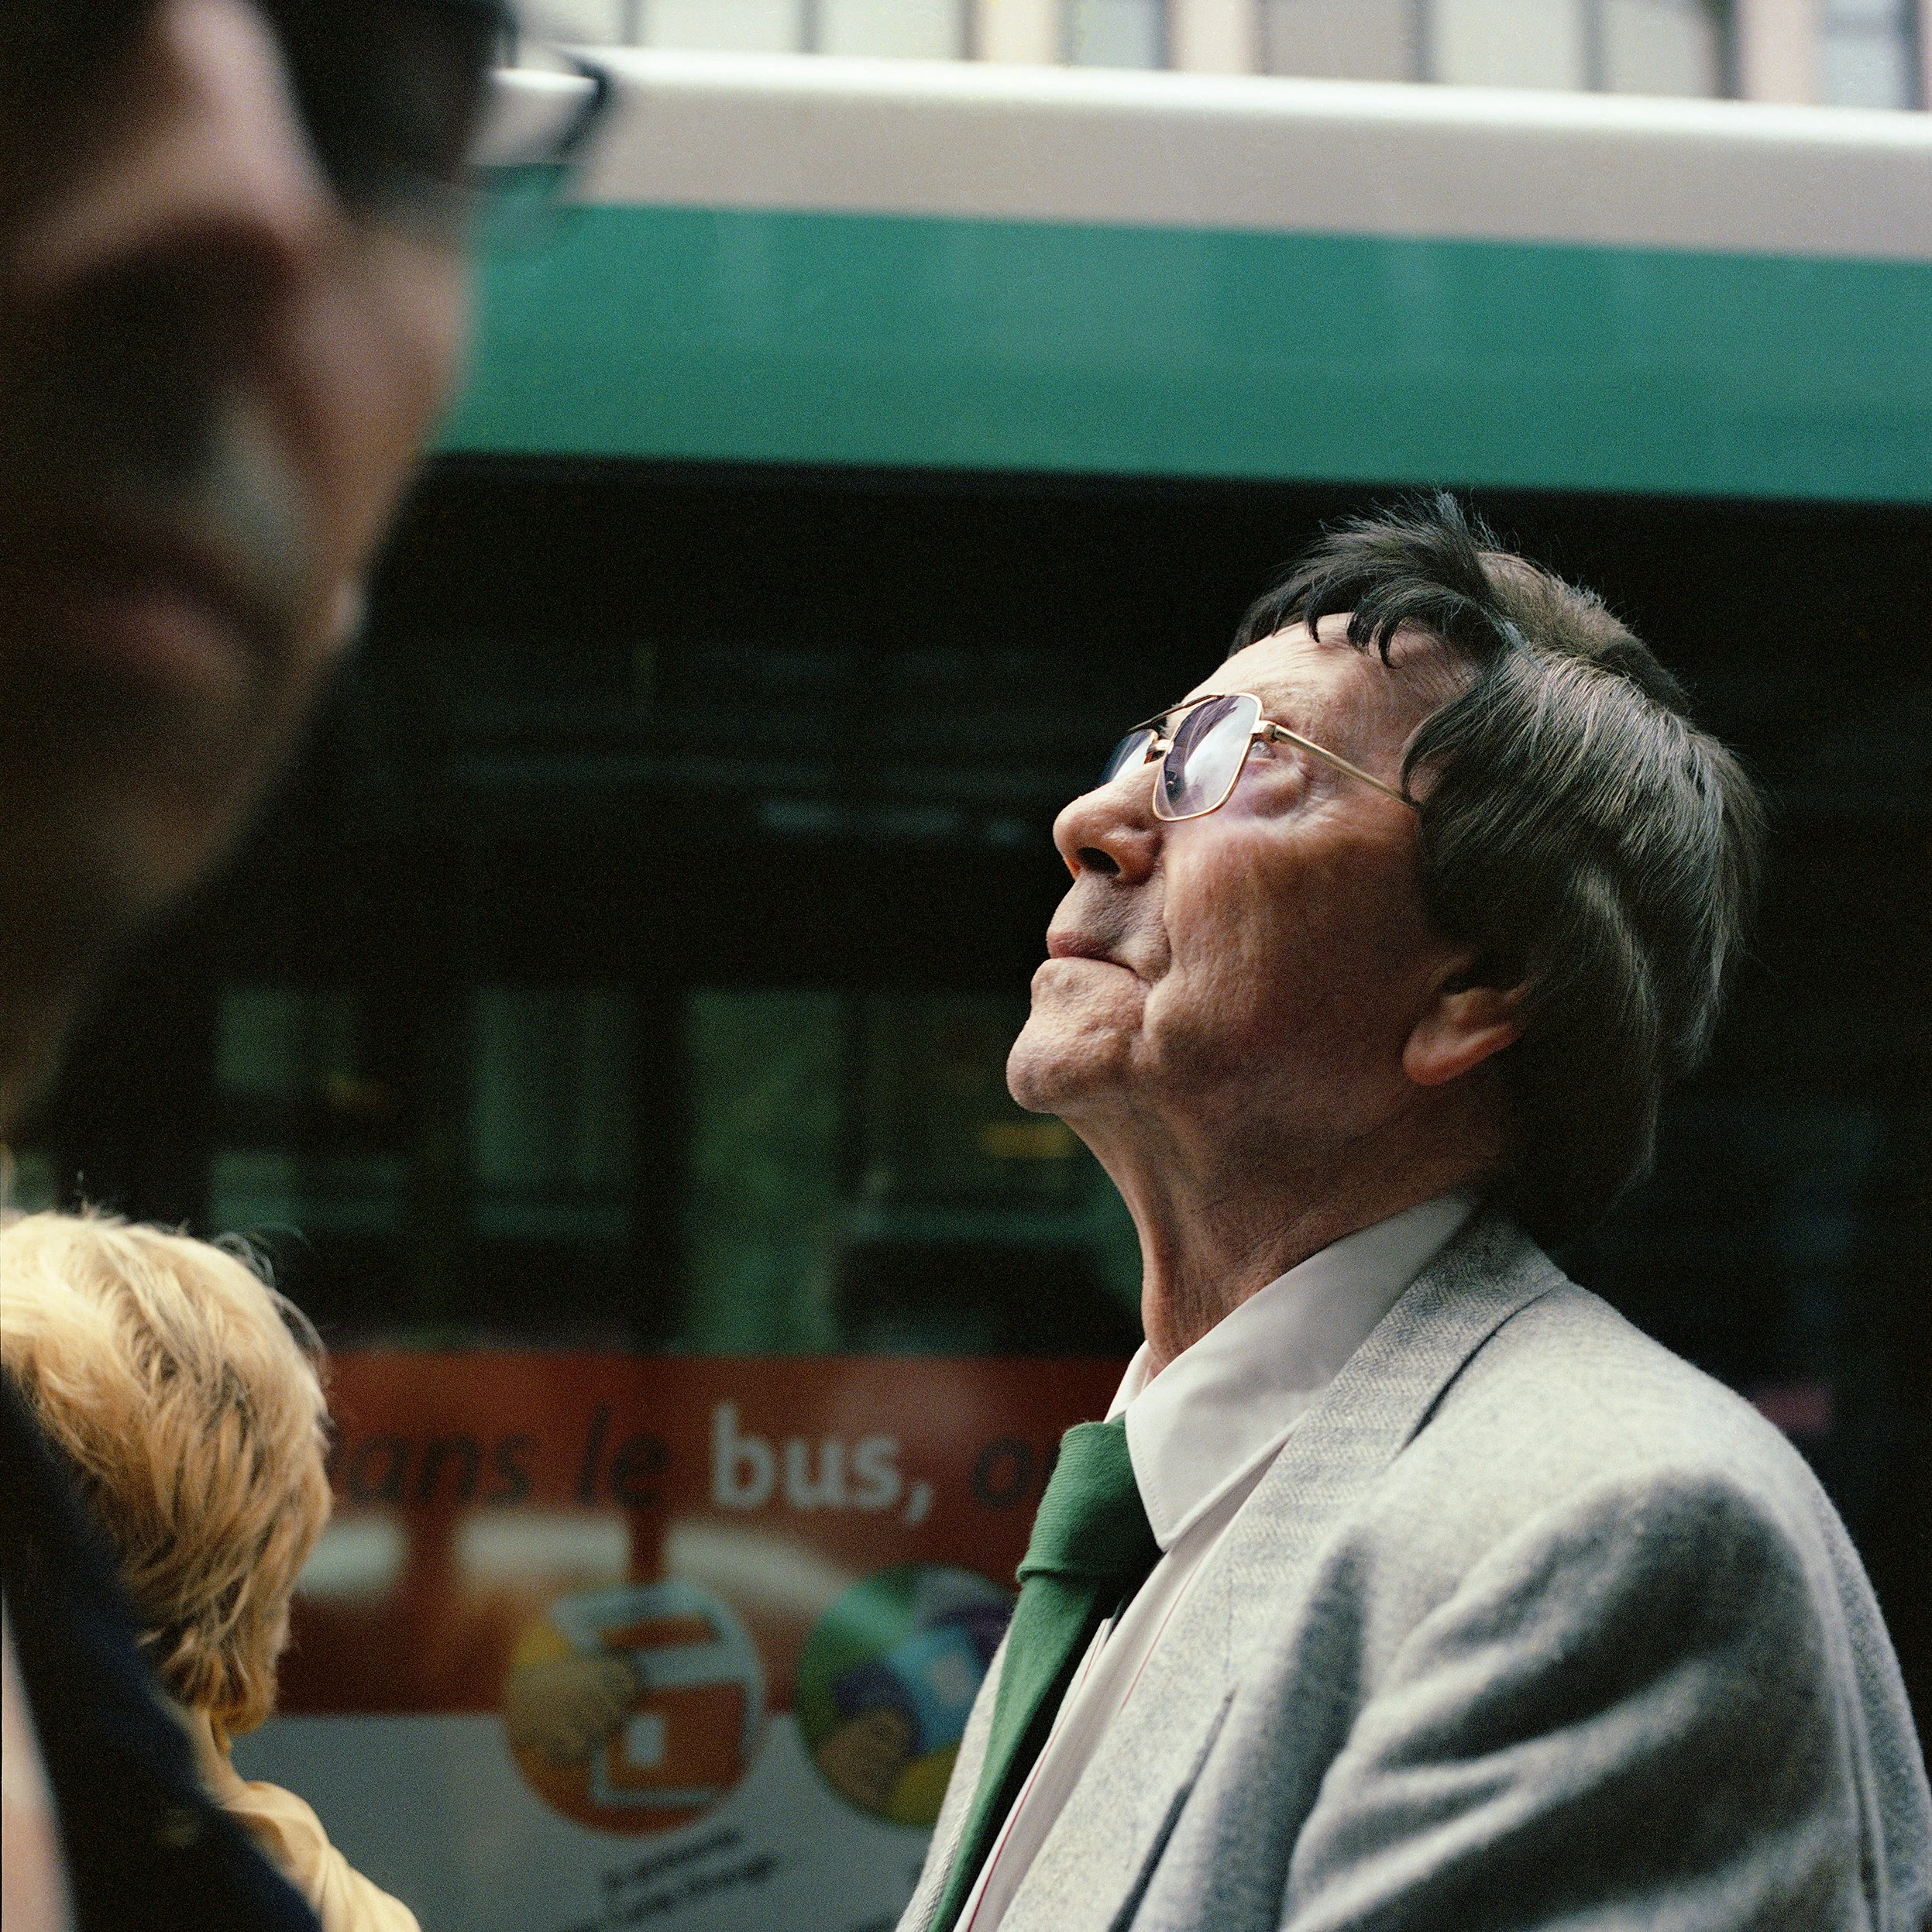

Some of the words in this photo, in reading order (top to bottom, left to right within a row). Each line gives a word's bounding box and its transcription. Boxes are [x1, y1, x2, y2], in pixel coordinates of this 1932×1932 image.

[325, 1422, 535, 1506] ans
[579, 1402, 672, 1508] le
[713, 1401, 933, 1525] bus,
[970, 1435, 1060, 1511] o
